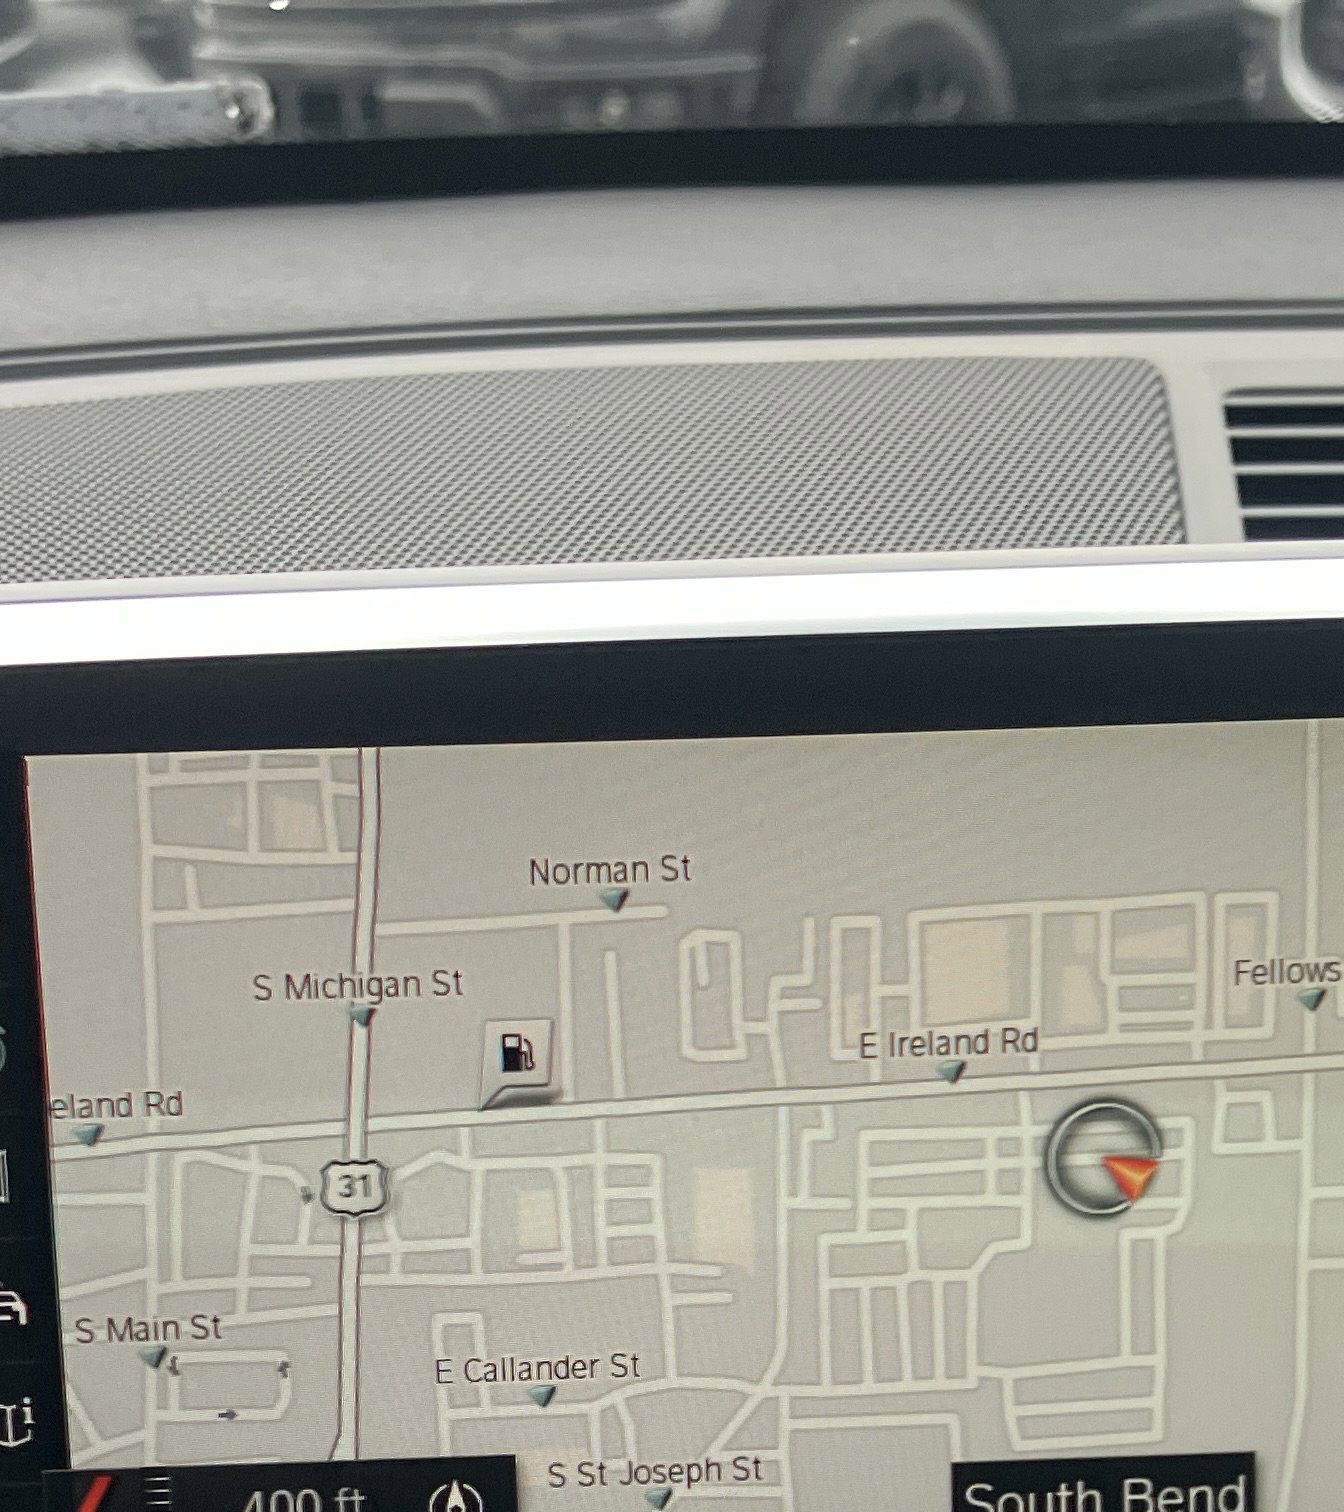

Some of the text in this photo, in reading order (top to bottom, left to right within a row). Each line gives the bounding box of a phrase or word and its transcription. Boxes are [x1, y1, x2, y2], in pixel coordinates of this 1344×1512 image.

[529, 855, 692, 887] Norman St
[254, 969, 464, 1004] S Michigan St
[1233, 957, 1342, 986] Fellows
[860, 1028, 1039, 1059] E Ireland Rd
[144, 1090, 183, 1117] Rd
[338, 1174, 372, 1198] 31
[75, 1313, 222, 1345] S Main St
[435, 1352, 640, 1385] E Callander St
[548, 1456, 763, 1490] S St Joseph St
